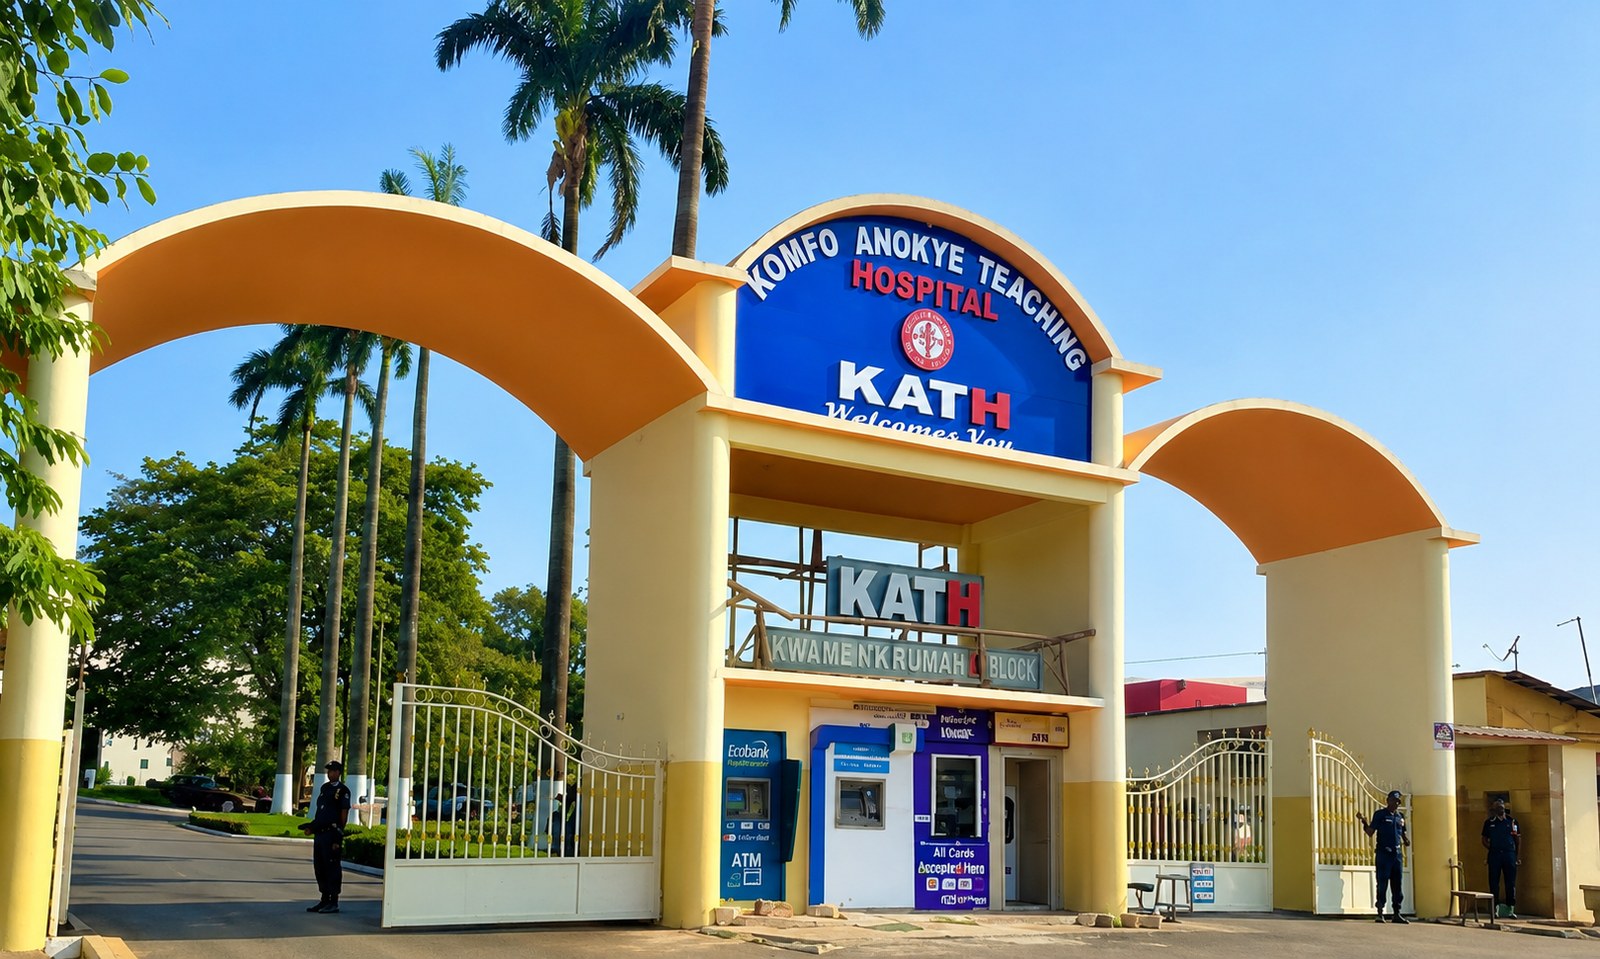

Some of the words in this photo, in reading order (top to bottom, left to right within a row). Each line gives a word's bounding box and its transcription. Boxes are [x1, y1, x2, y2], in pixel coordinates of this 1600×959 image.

[745, 228, 839, 301] KOMFO
[855, 226, 965, 274] ANOKYE
[978, 255, 1087, 372] TEACHING
[852, 259, 999, 321] HOSPITAL
[839, 360, 1011, 430] KATH
[825, 402, 960, 441] Welcomes
[839, 566, 980, 628] KATH
[989, 655, 1037, 682] BLOCK
[728, 742, 770, 759] Ecobank
[731, 852, 762, 868] ATM
[933, 847, 946, 858] All
[948, 847, 975, 859] Cards
